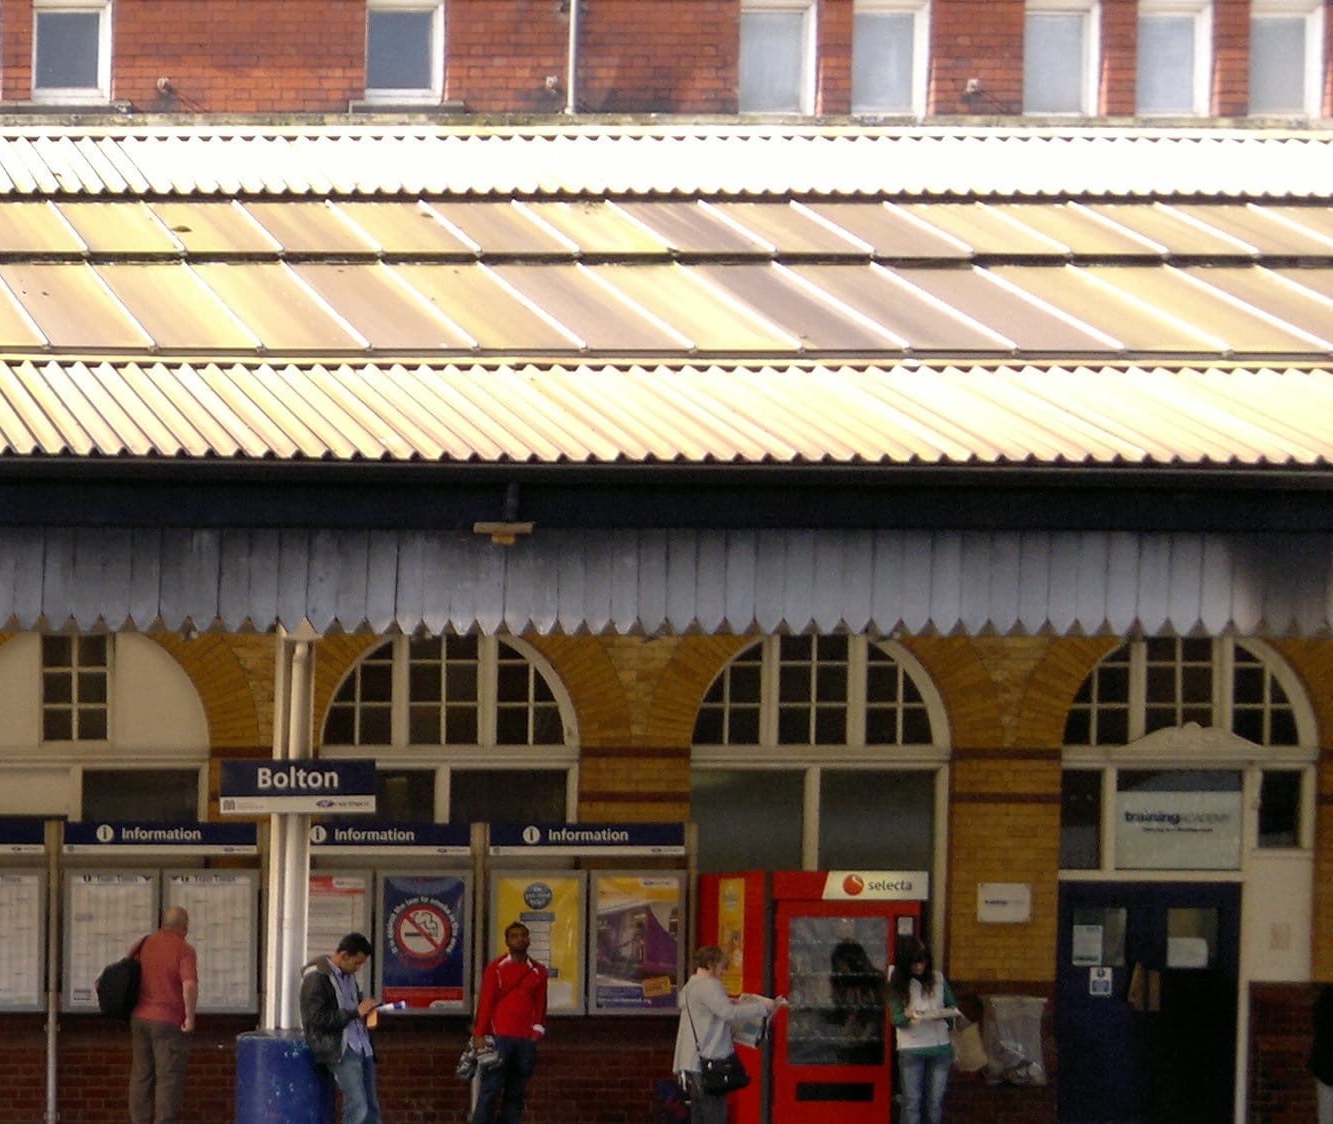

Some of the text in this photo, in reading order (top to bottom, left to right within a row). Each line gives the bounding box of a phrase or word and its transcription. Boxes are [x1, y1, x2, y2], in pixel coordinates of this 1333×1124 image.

[257, 766, 339, 788] Bolton
[1125, 811, 1181, 825] training
[121, 827, 202, 840] Information
[334, 828, 415, 841] Information
[548, 828, 629, 841] Information
[868, 880, 913, 891] selecta
